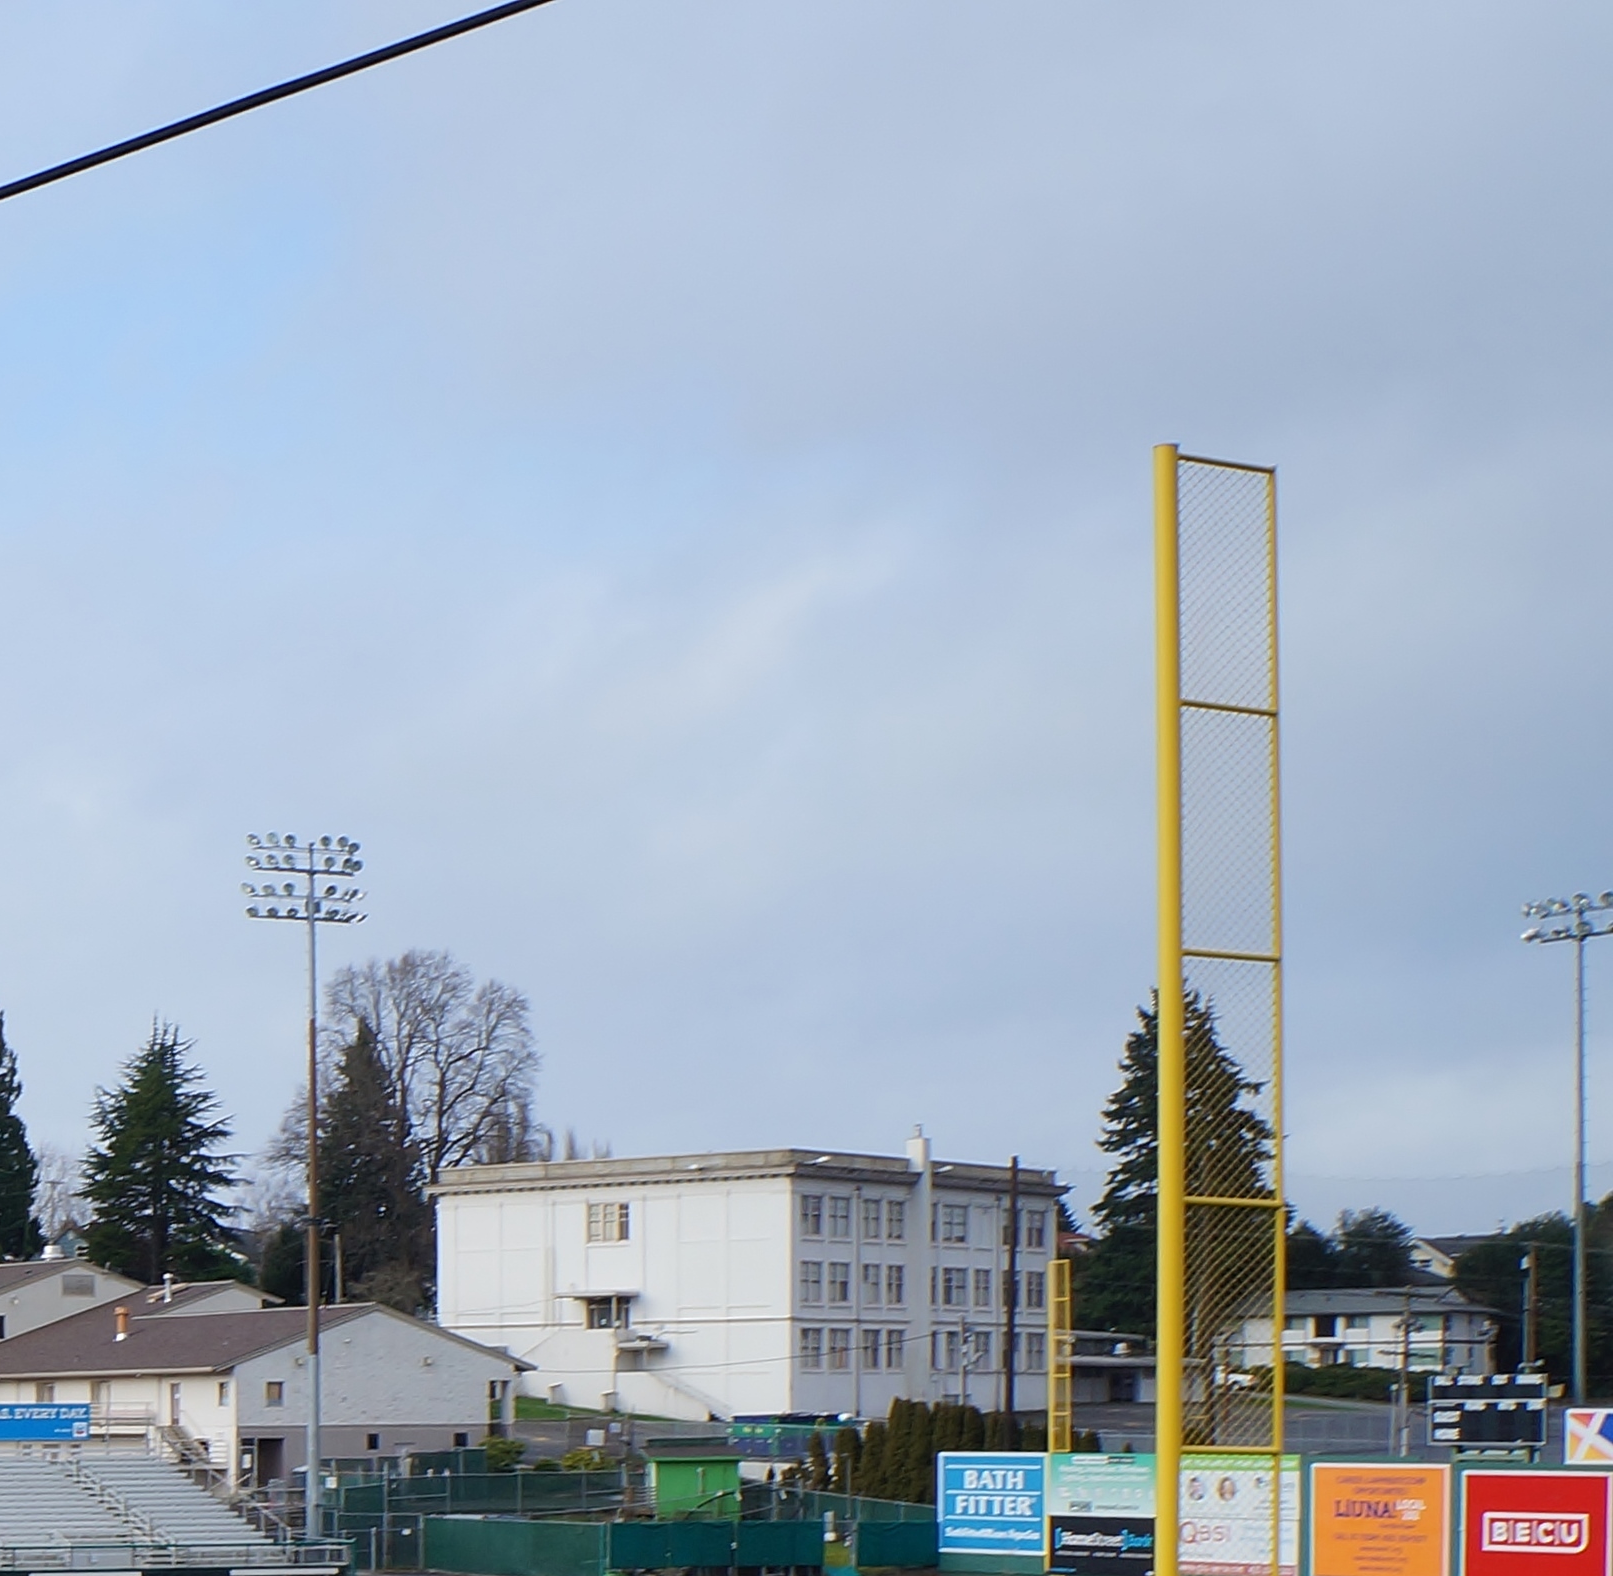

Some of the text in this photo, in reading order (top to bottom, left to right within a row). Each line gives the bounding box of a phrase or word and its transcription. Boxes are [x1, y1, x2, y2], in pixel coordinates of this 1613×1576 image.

[14, 1408, 57, 1420] EVERY
[963, 1469, 1025, 1490] BATH
[954, 1495, 1033, 1516] FITTER
[1490, 1519, 1580, 1546] BECU
